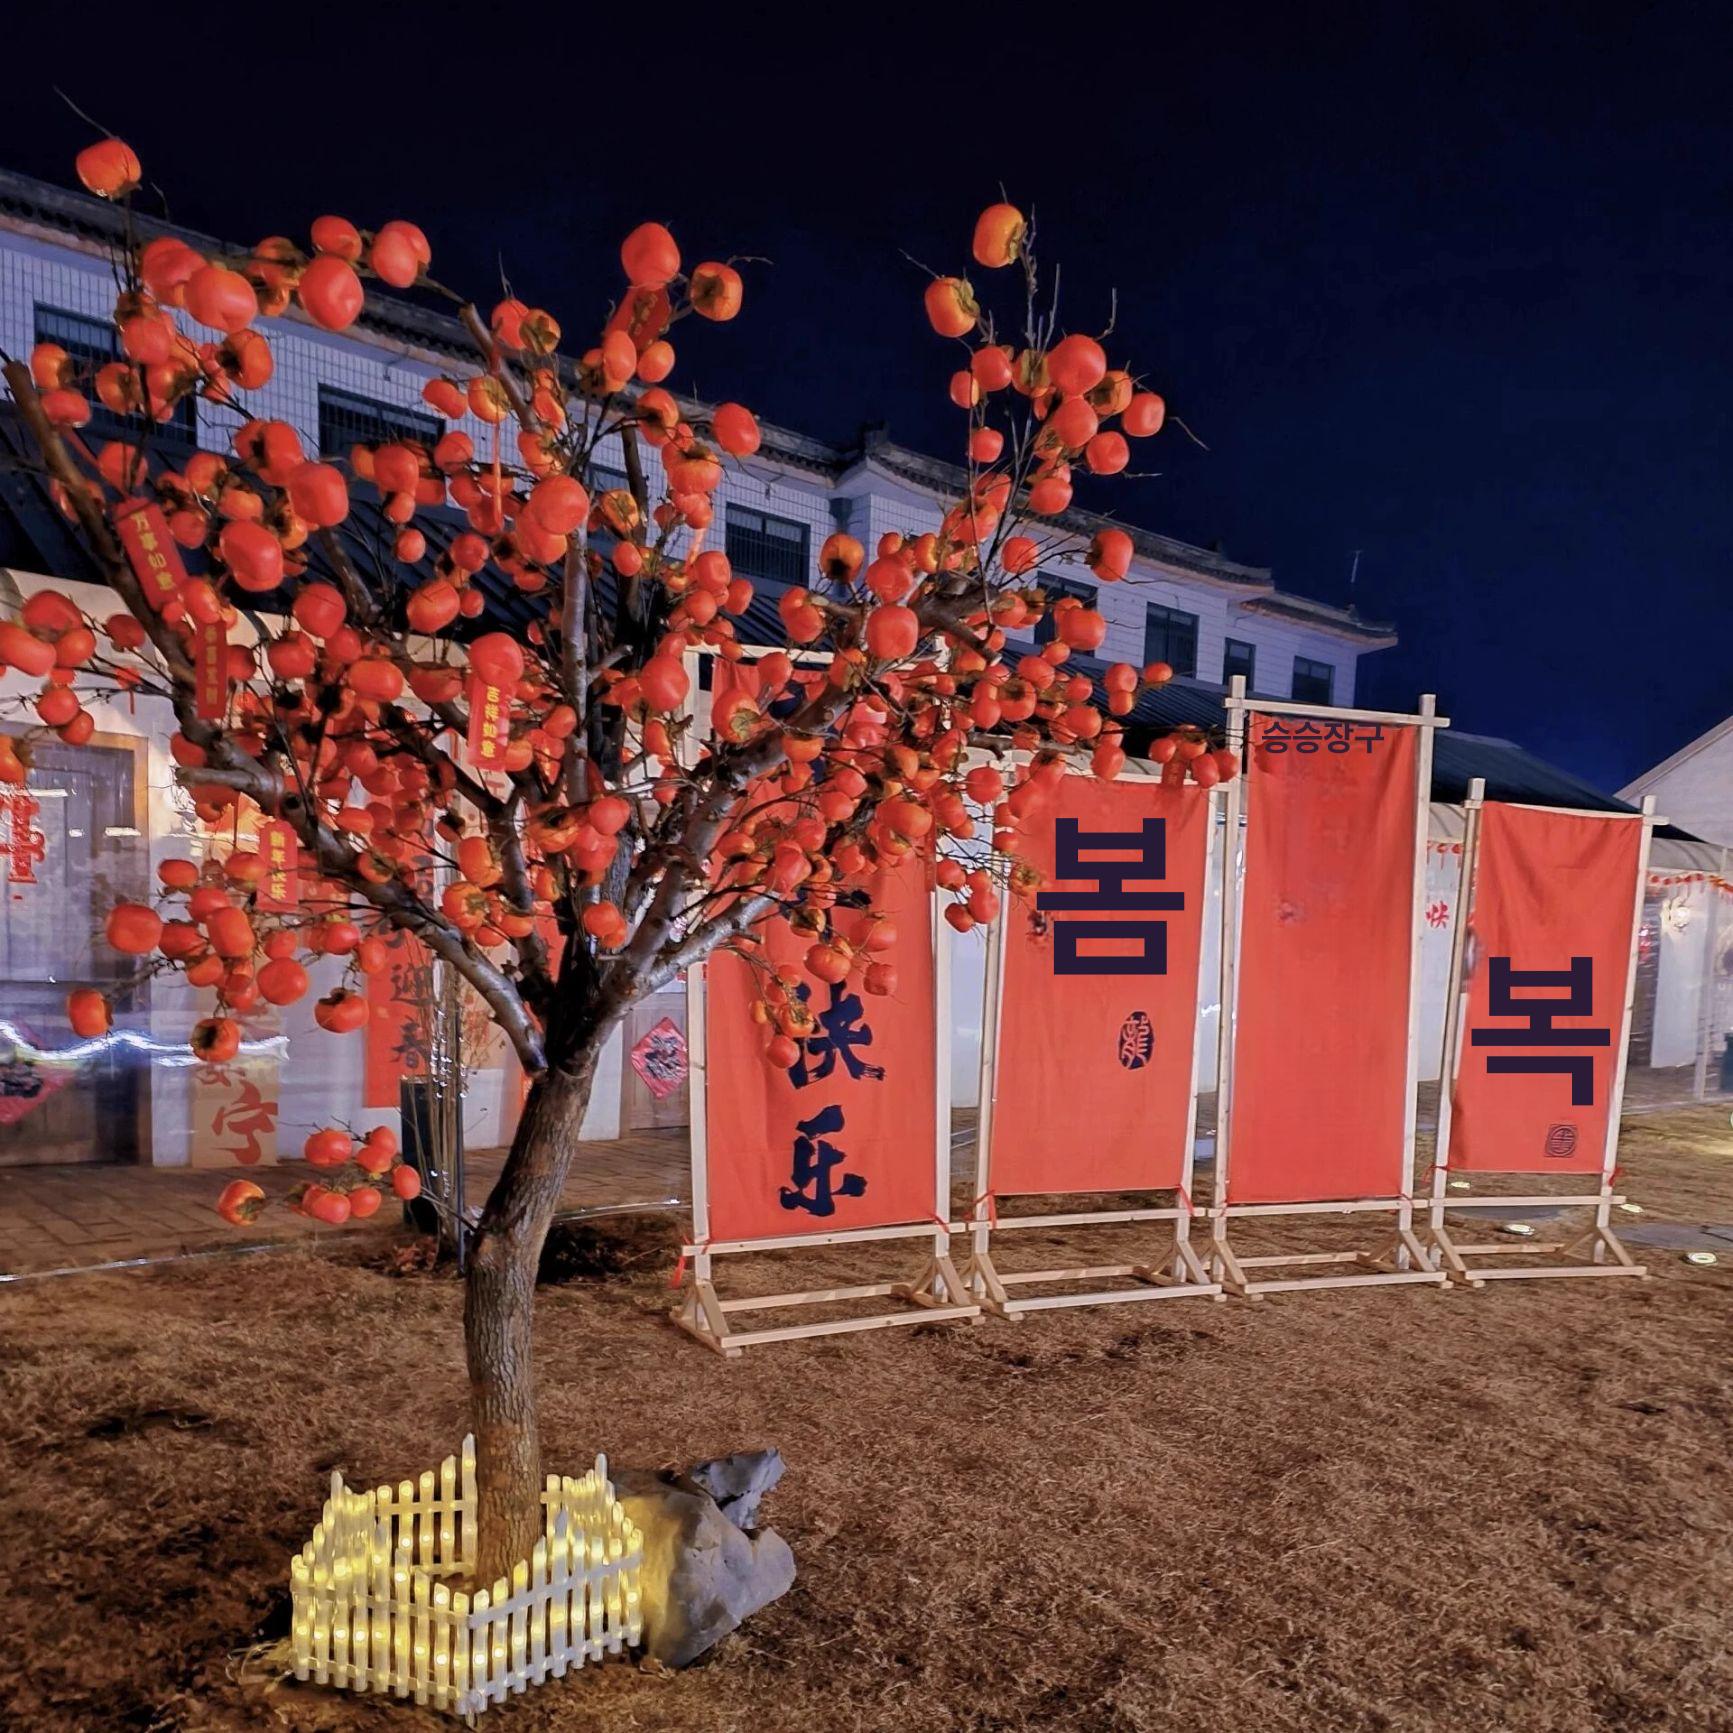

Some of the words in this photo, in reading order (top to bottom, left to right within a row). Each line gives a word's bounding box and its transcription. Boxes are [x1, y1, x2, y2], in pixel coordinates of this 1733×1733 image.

[1262, 721, 1384, 753] 승승장구
[1037, 818, 1184, 974] 봄
[1472, 957, 1610, 1105] 복
